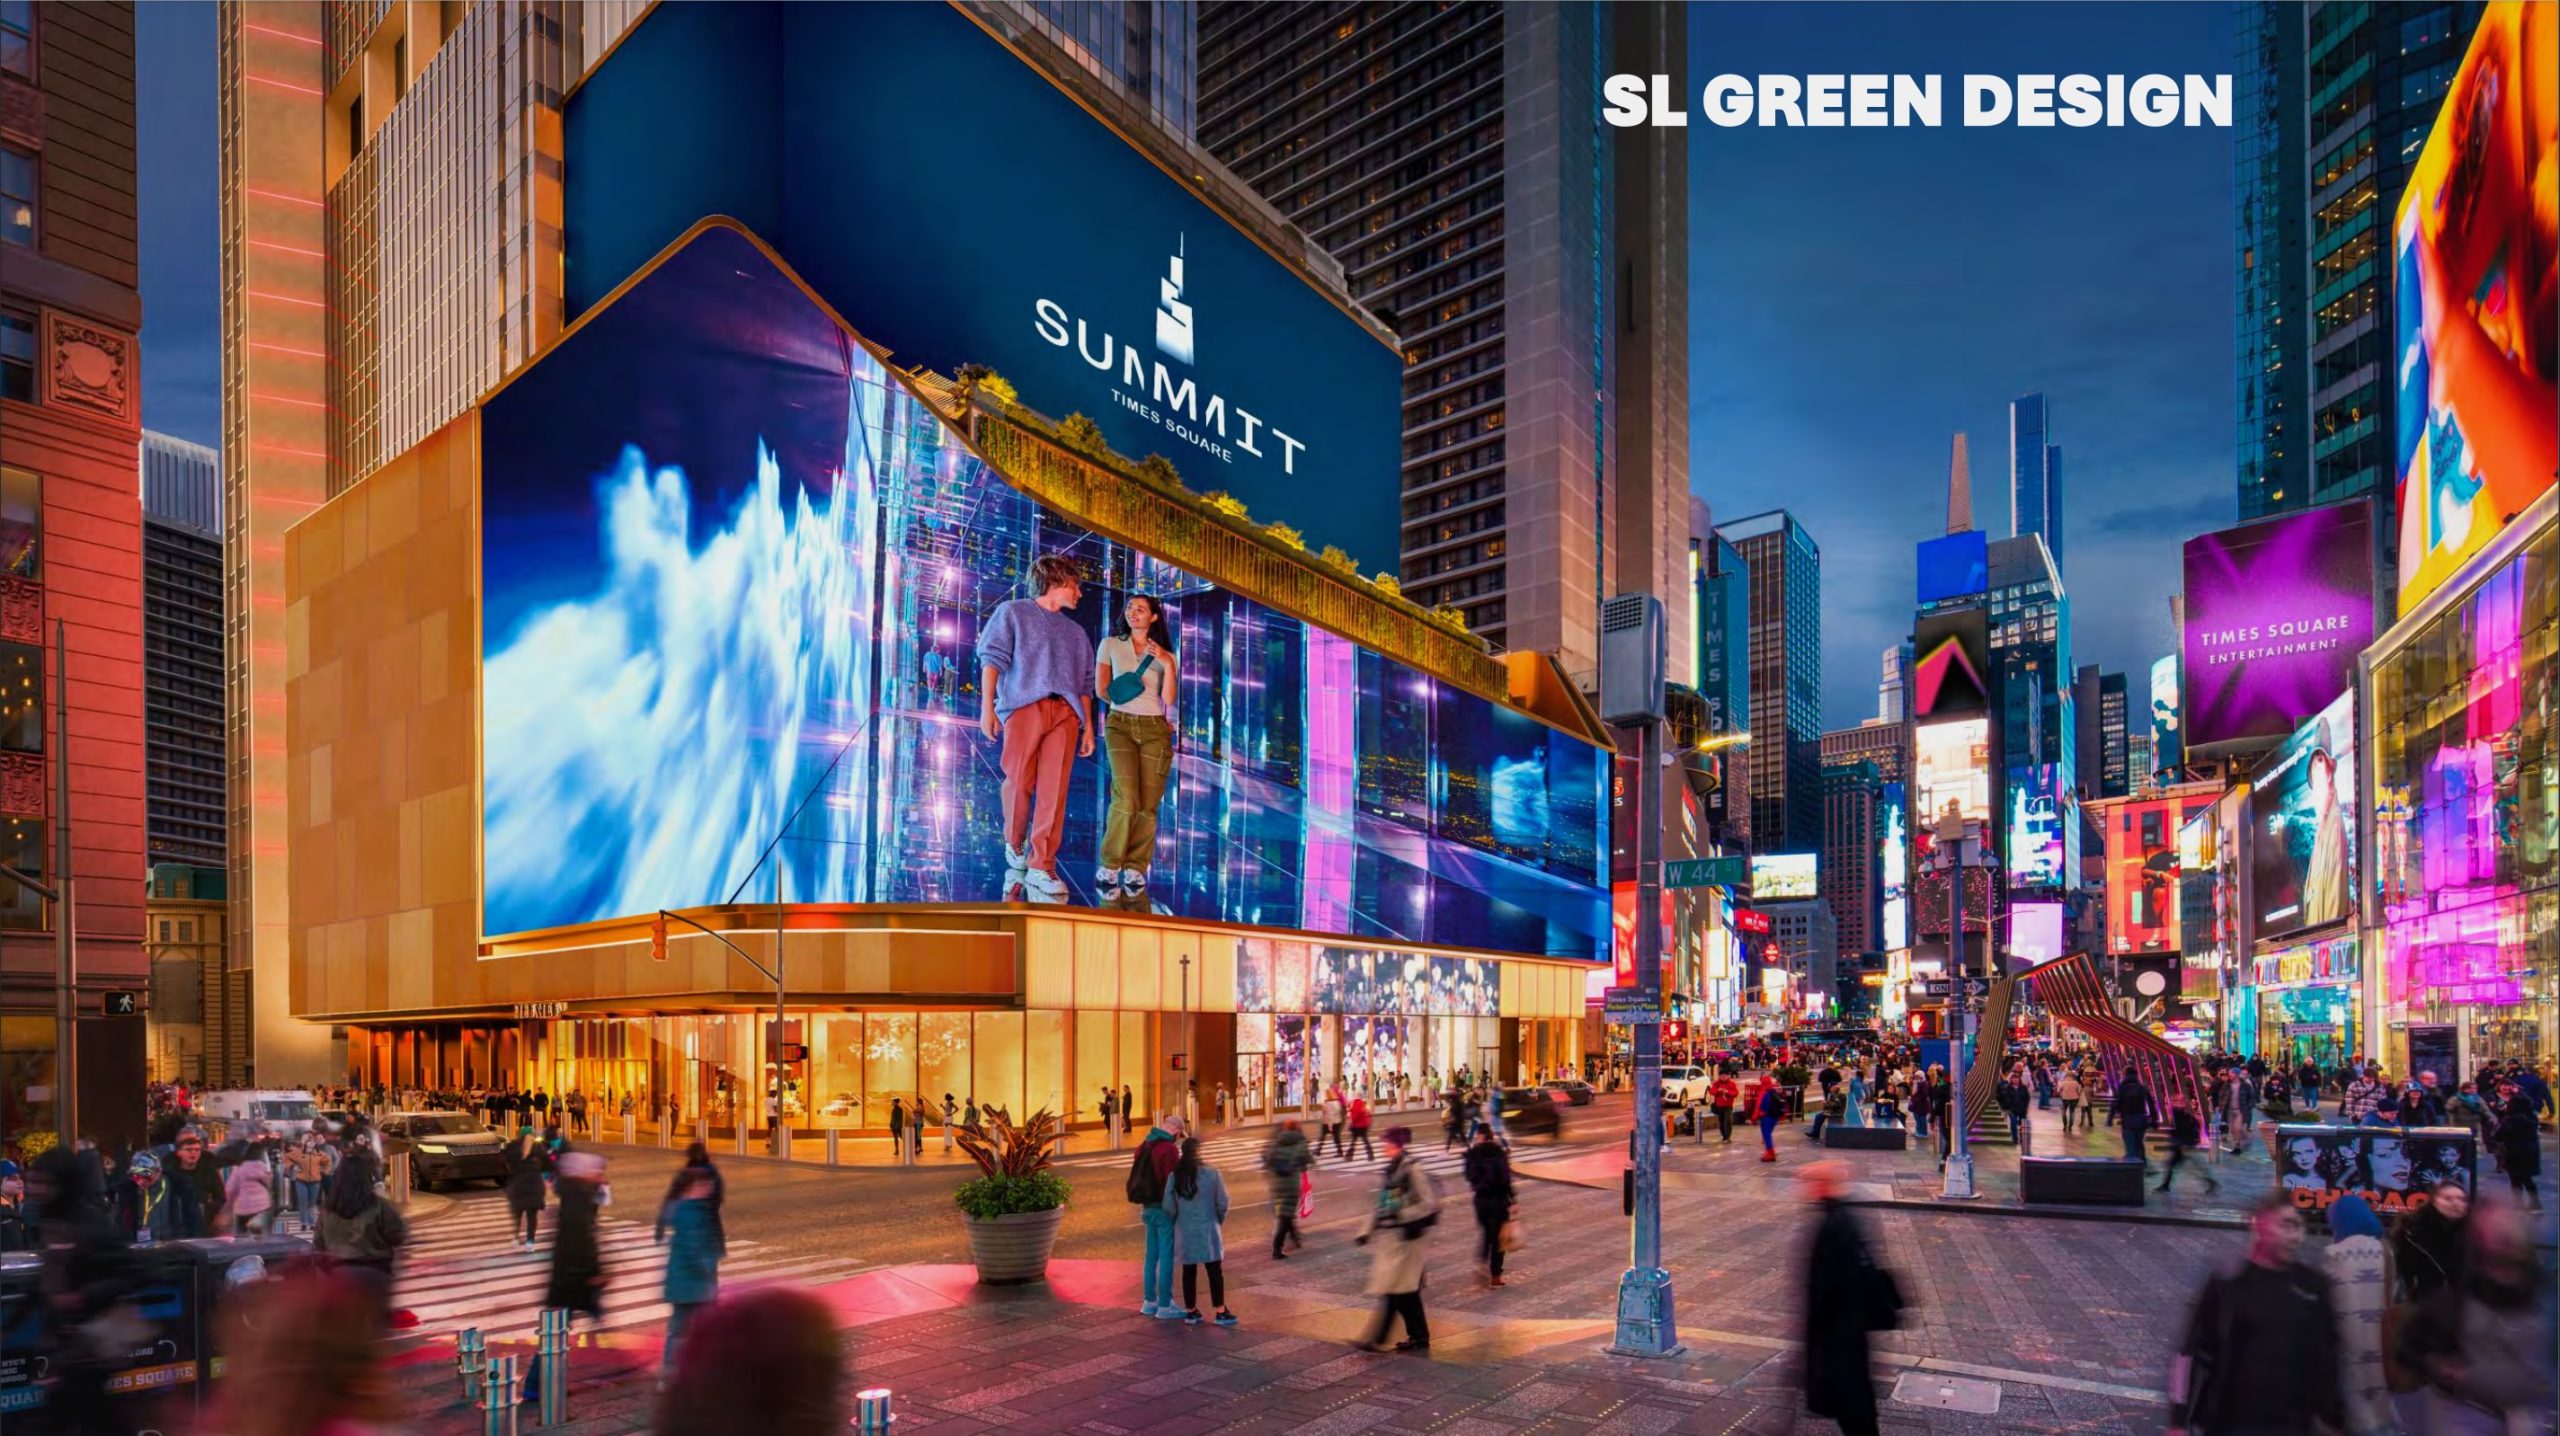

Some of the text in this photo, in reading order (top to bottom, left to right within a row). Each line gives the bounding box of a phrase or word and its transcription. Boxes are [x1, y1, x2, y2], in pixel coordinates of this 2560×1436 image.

[1111, 388, 1232, 464] TIMES SQUARE
[1707, 591, 1723, 682] TIMES
[2201, 615, 2350, 647] TIMES SQUARE
[2209, 638, 2339, 665] ENTERTAINMENT
[1669, 864, 1683, 884] W
[1691, 862, 1716, 882] 44
[136, 1366, 194, 1386] SQUARE
